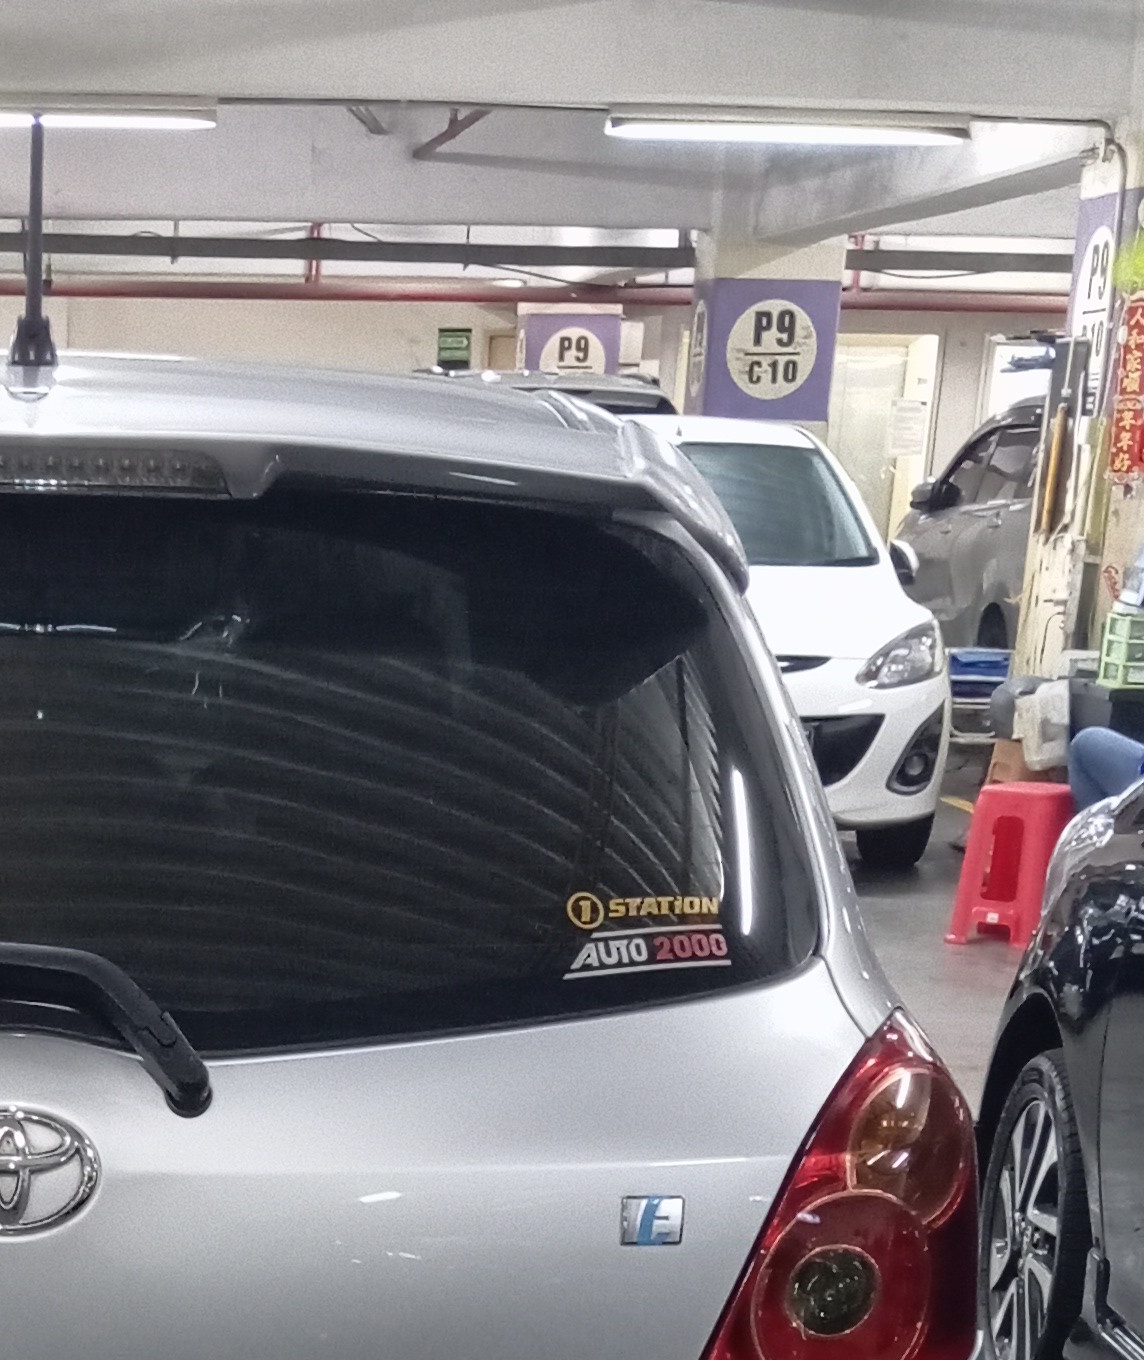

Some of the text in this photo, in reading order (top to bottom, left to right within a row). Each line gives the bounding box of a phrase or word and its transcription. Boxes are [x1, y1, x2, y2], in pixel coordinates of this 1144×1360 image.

[1088, 239, 1110, 300] P9
[754, 308, 796, 348] P9
[558, 335, 590, 363] P9
[748, 359, 798, 385] C10
[570, 933, 728, 970] AUTO 2000
